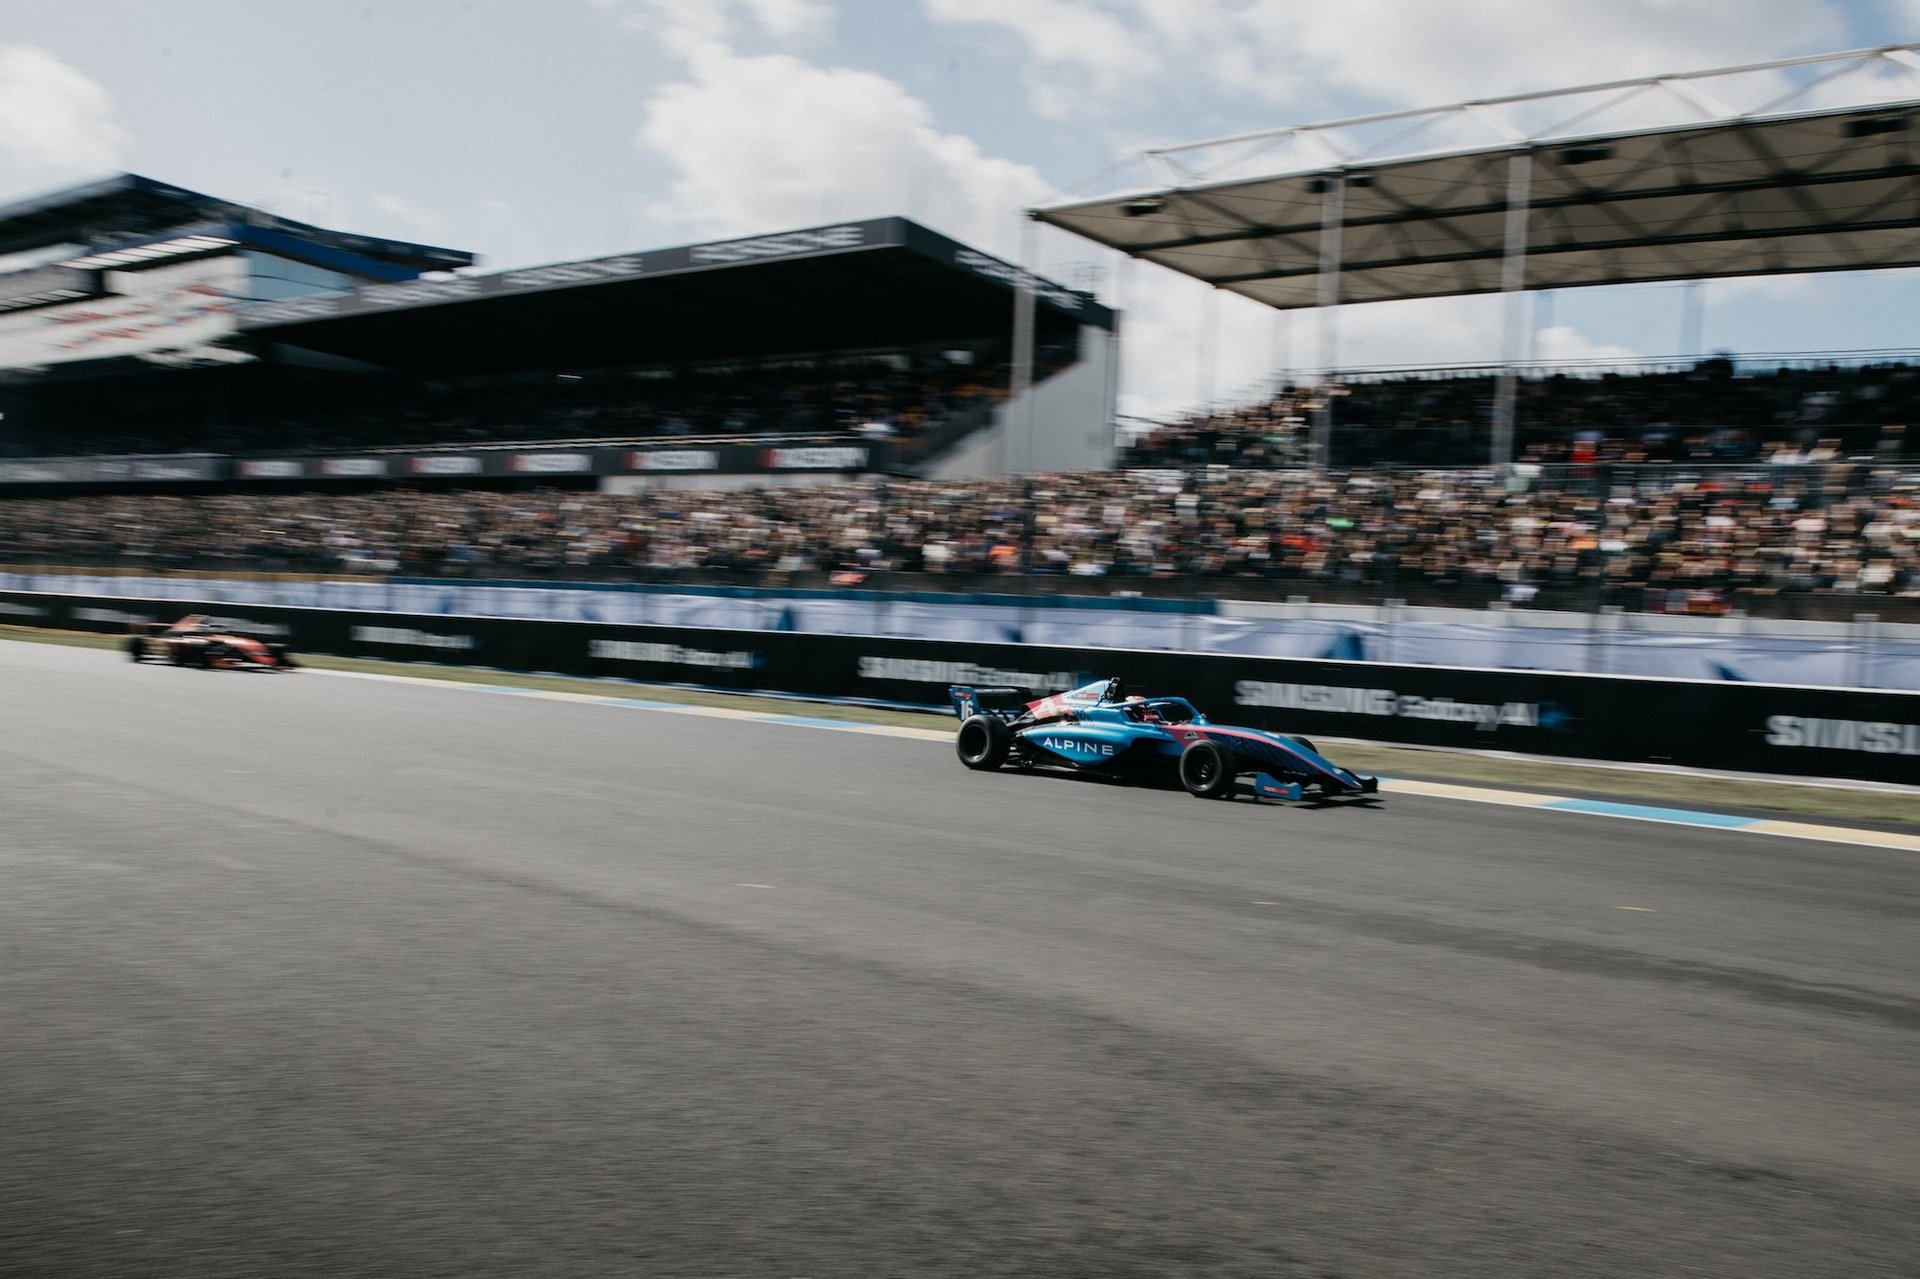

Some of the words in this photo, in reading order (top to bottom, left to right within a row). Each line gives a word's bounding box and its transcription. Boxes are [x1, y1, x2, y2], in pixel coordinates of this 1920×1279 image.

[1235, 680, 1397, 716] SAMSUNG
[960, 700, 974, 720] 16
[1043, 736, 1114, 756] ALPINE
